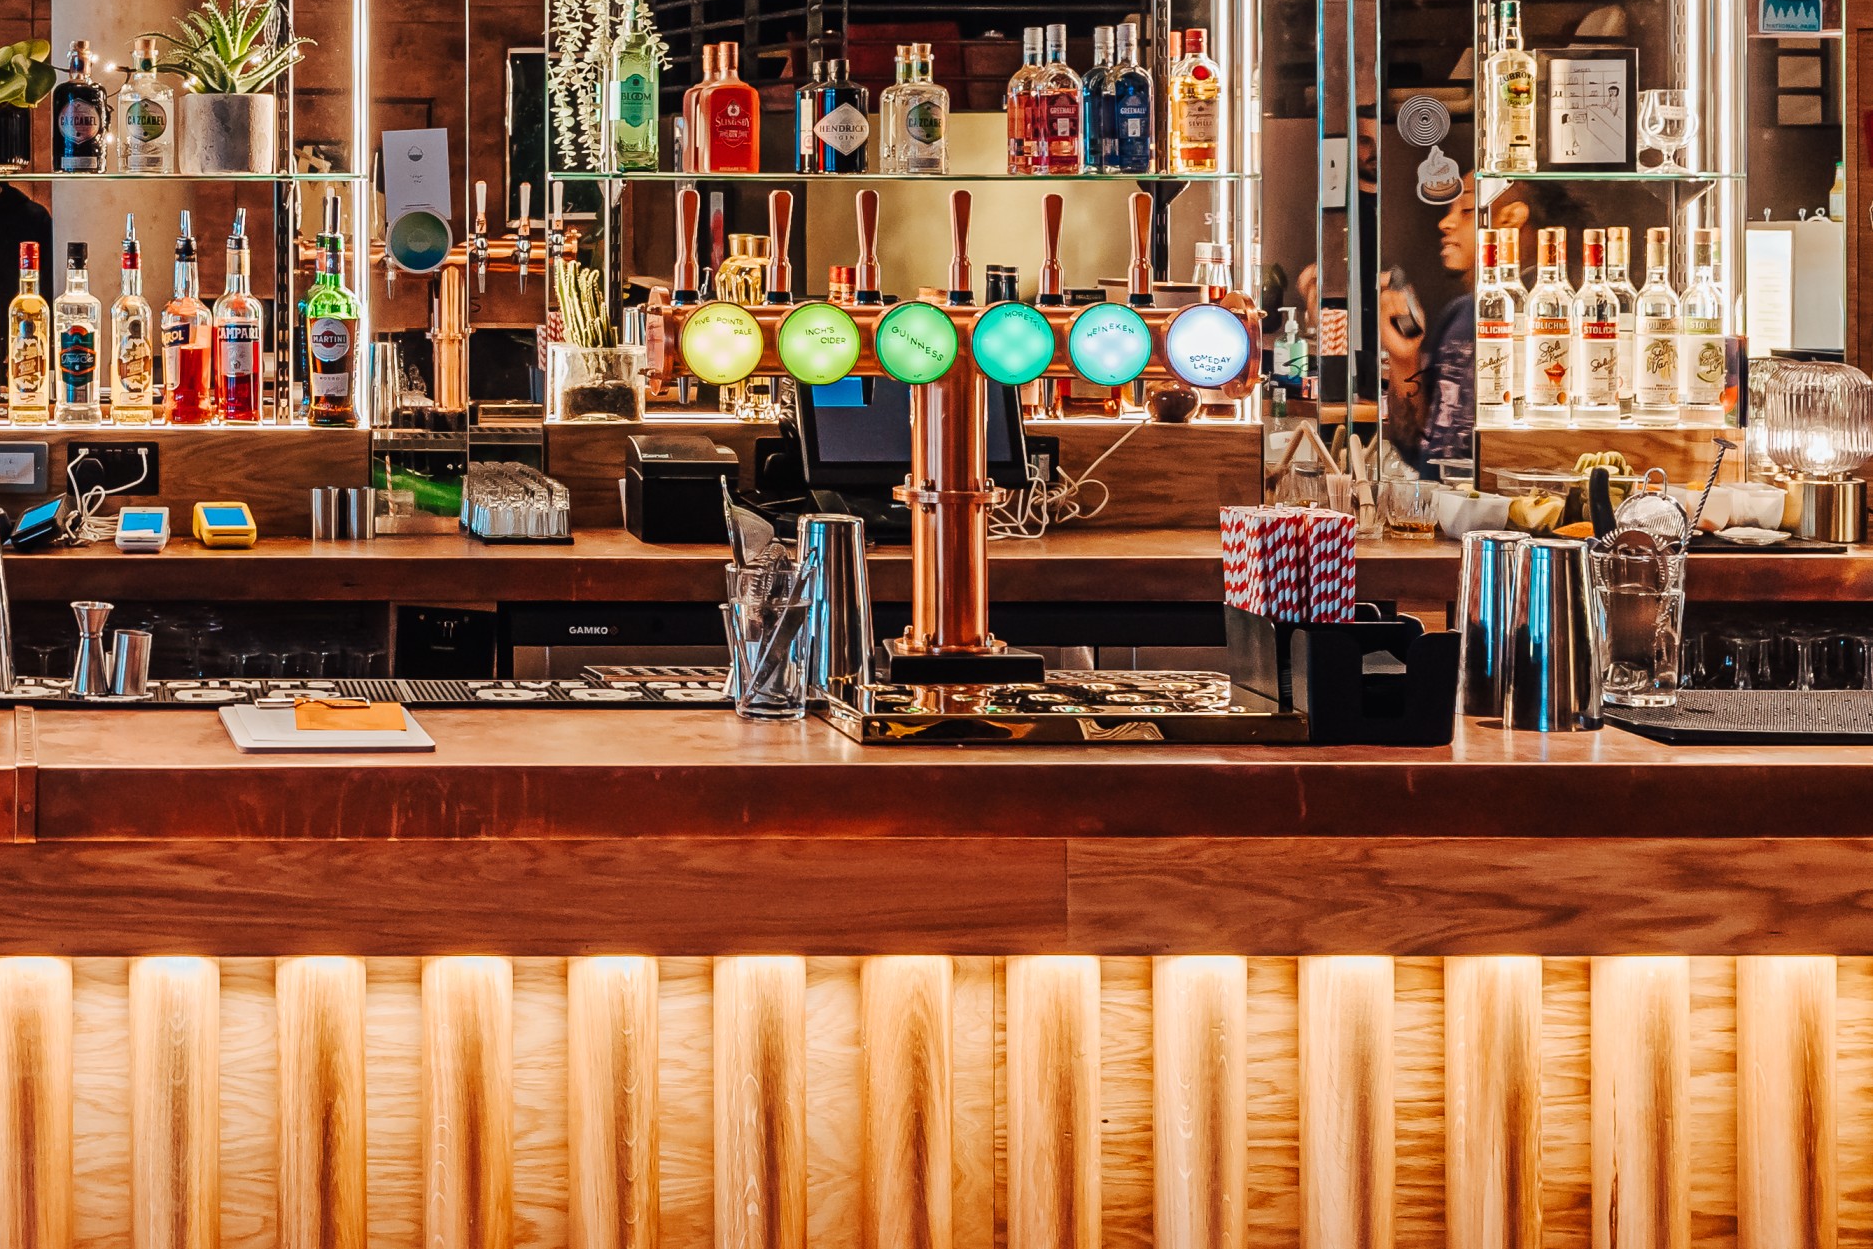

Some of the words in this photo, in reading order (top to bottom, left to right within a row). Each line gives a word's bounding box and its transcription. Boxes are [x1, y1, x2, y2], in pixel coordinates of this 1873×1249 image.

[621, 92, 652, 101] BLOOM
[127, 115, 165, 127] CAZCABEL
[715, 117, 750, 128] SLINGSBY
[694, 316, 710, 326] FIVE
[716, 317, 743, 326] POINTS
[1004, 311, 1041, 332] MORETTI
[733, 328, 752, 336] PALE
[805, 327, 835, 336] INCH'S
[1086, 323, 1135, 338] HEINEKEN
[312, 335, 347, 343] MARTINI
[820, 337, 846, 345] CIDER
[891, 326, 945, 362] GUINNESS
[1190, 355, 1231, 365] SOMEDAY
[1193, 363, 1223, 373] LAGER
[569, 626, 609, 635] GAMKO
